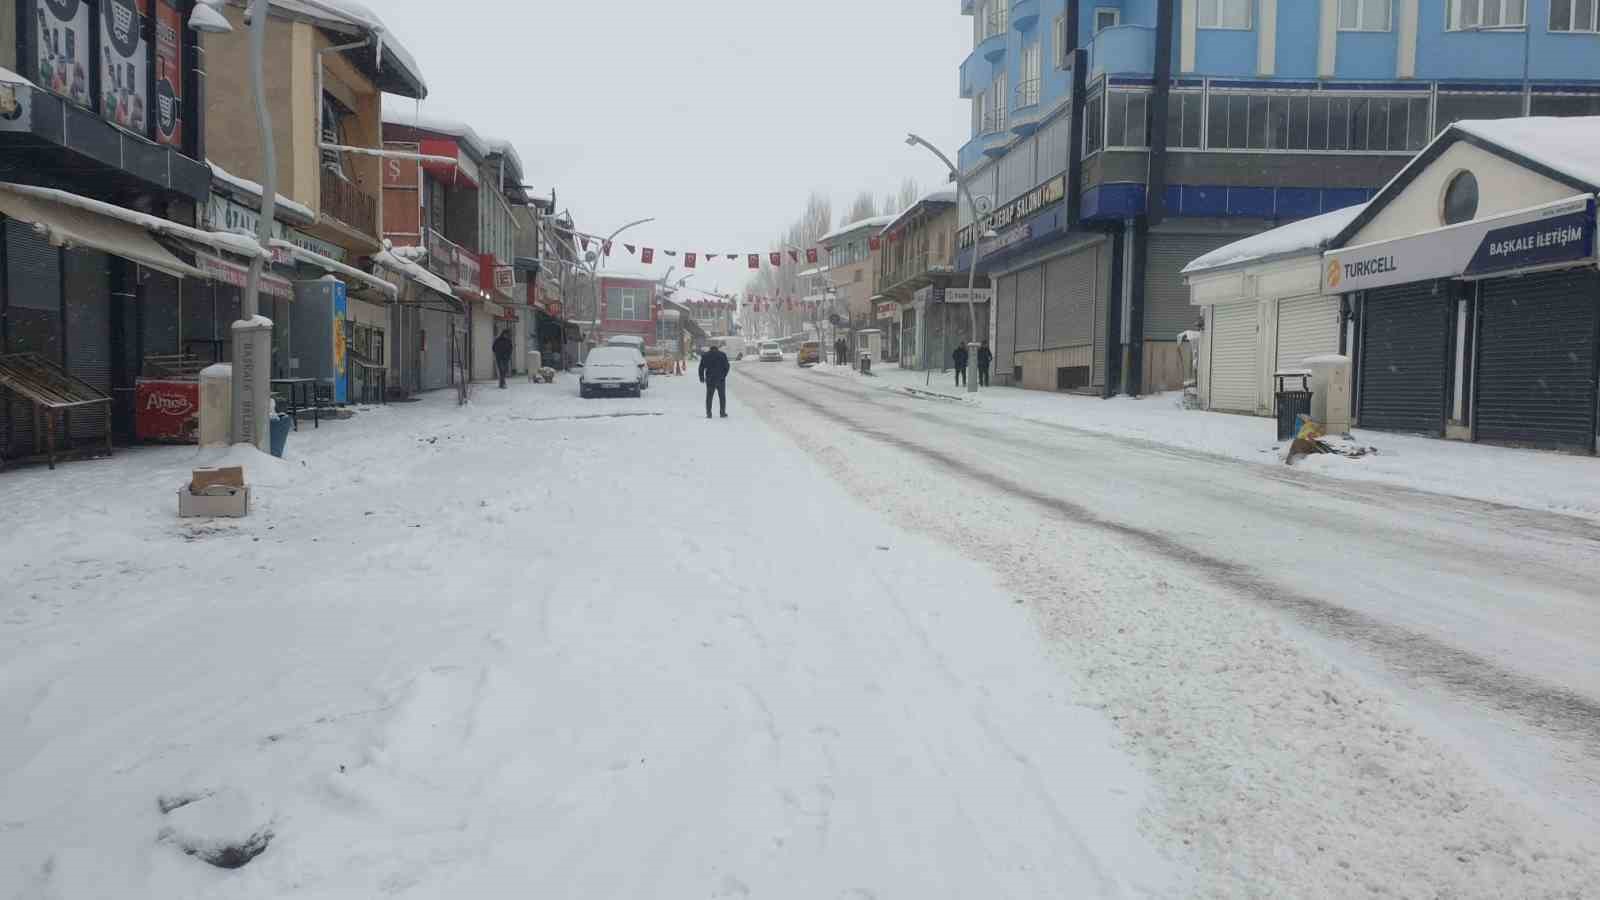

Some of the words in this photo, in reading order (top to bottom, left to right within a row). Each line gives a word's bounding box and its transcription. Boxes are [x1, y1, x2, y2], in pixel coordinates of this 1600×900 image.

[1489, 236, 1535, 256] BAŞKALE
[1536, 225, 1583, 247] İLETİŞİM
[1344, 256, 1397, 279] TURKCELL
